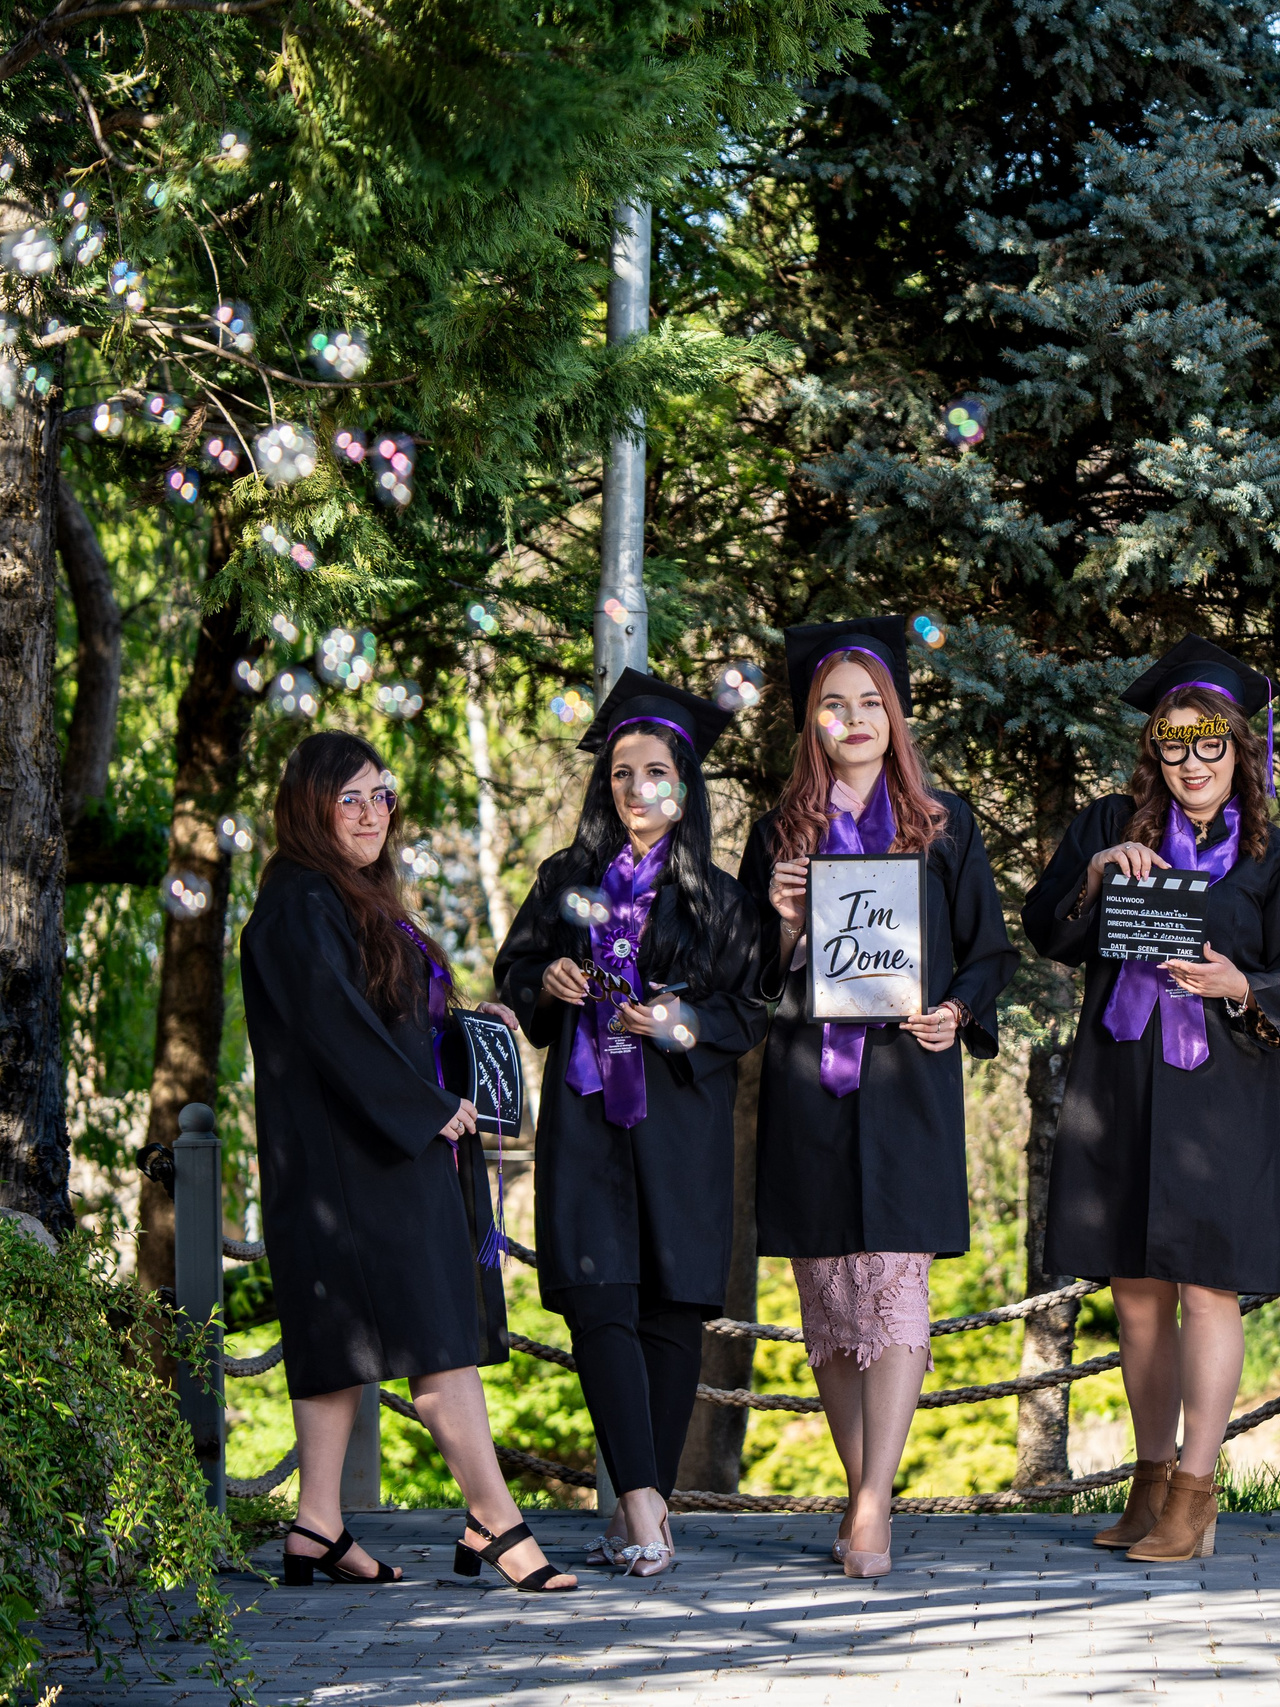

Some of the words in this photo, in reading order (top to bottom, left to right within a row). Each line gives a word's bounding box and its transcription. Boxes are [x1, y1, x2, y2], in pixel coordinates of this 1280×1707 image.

[1152, 713, 1230, 746] Congrats
[1106, 895, 1145, 904] HOLLYWOOD
[839, 889, 900, 933] I'm
[1105, 907, 1139, 916] PRODUCTION
[1107, 920, 1133, 928] DIRECTOR
[1107, 932, 1129, 940] CAMERA
[1137, 945, 1159, 953] SCENE
[823, 934, 914, 979] Done.
